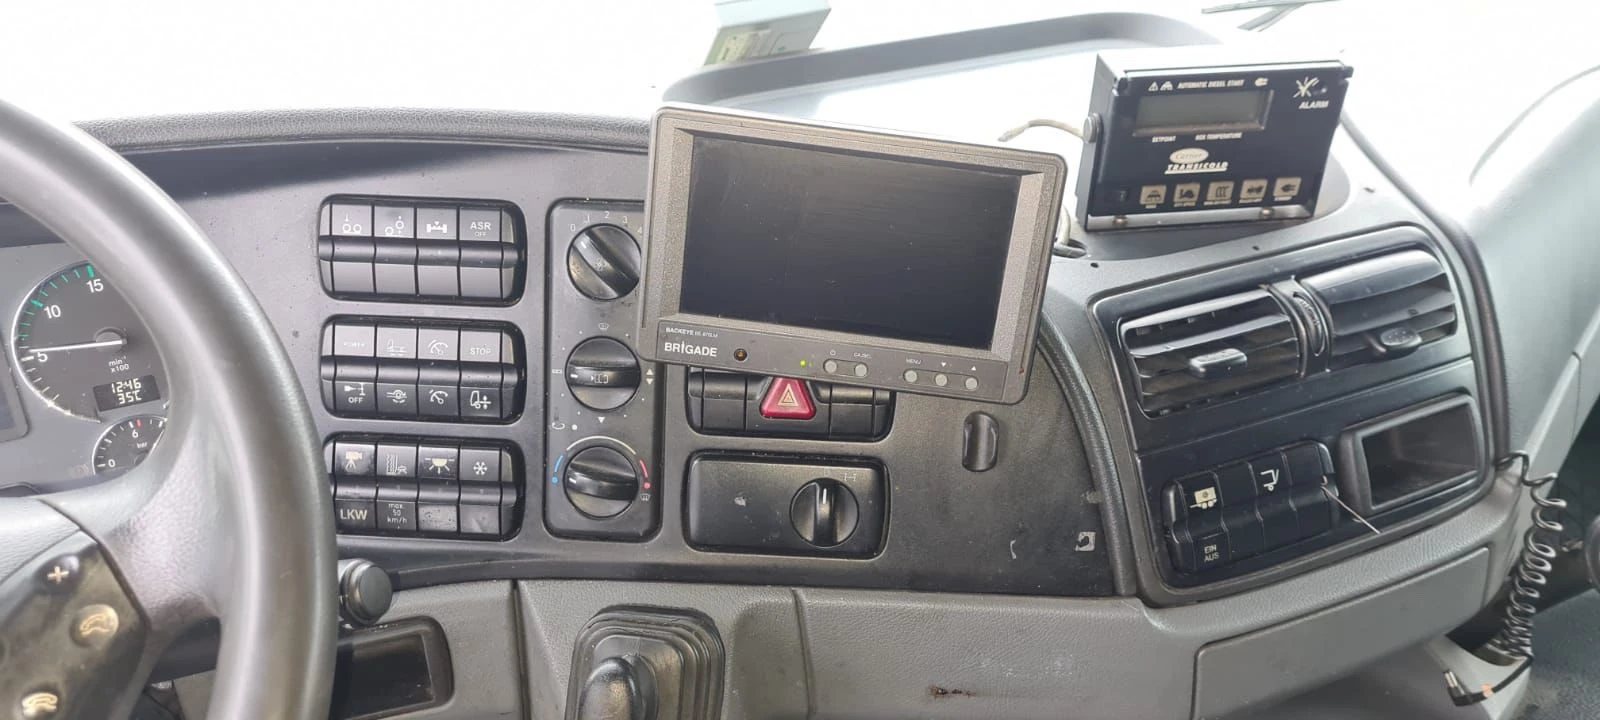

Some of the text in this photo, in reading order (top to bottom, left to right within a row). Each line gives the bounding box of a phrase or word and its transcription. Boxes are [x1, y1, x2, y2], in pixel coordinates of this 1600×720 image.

[1299, 100, 1329, 109] ALARM
[1167, 161, 1229, 171] TRANSICOLD
[604, 211, 610, 219] 2
[470, 221, 492, 231] ASR
[87, 278, 104, 293] 15
[44, 304, 62, 318] 10
[470, 347, 492, 355] STOP
[664, 340, 719, 357] BRIGADE
[37, 352, 48, 362] 5
[348, 396, 363, 404] OFF
[132, 429, 139, 438] 6
[108, 459, 116, 468] 0
[340, 508, 368, 521] LKW
[387, 515, 408, 524] km/h
[1204, 544, 1217, 554] EIN
[1203, 552, 1220, 562] AUS
